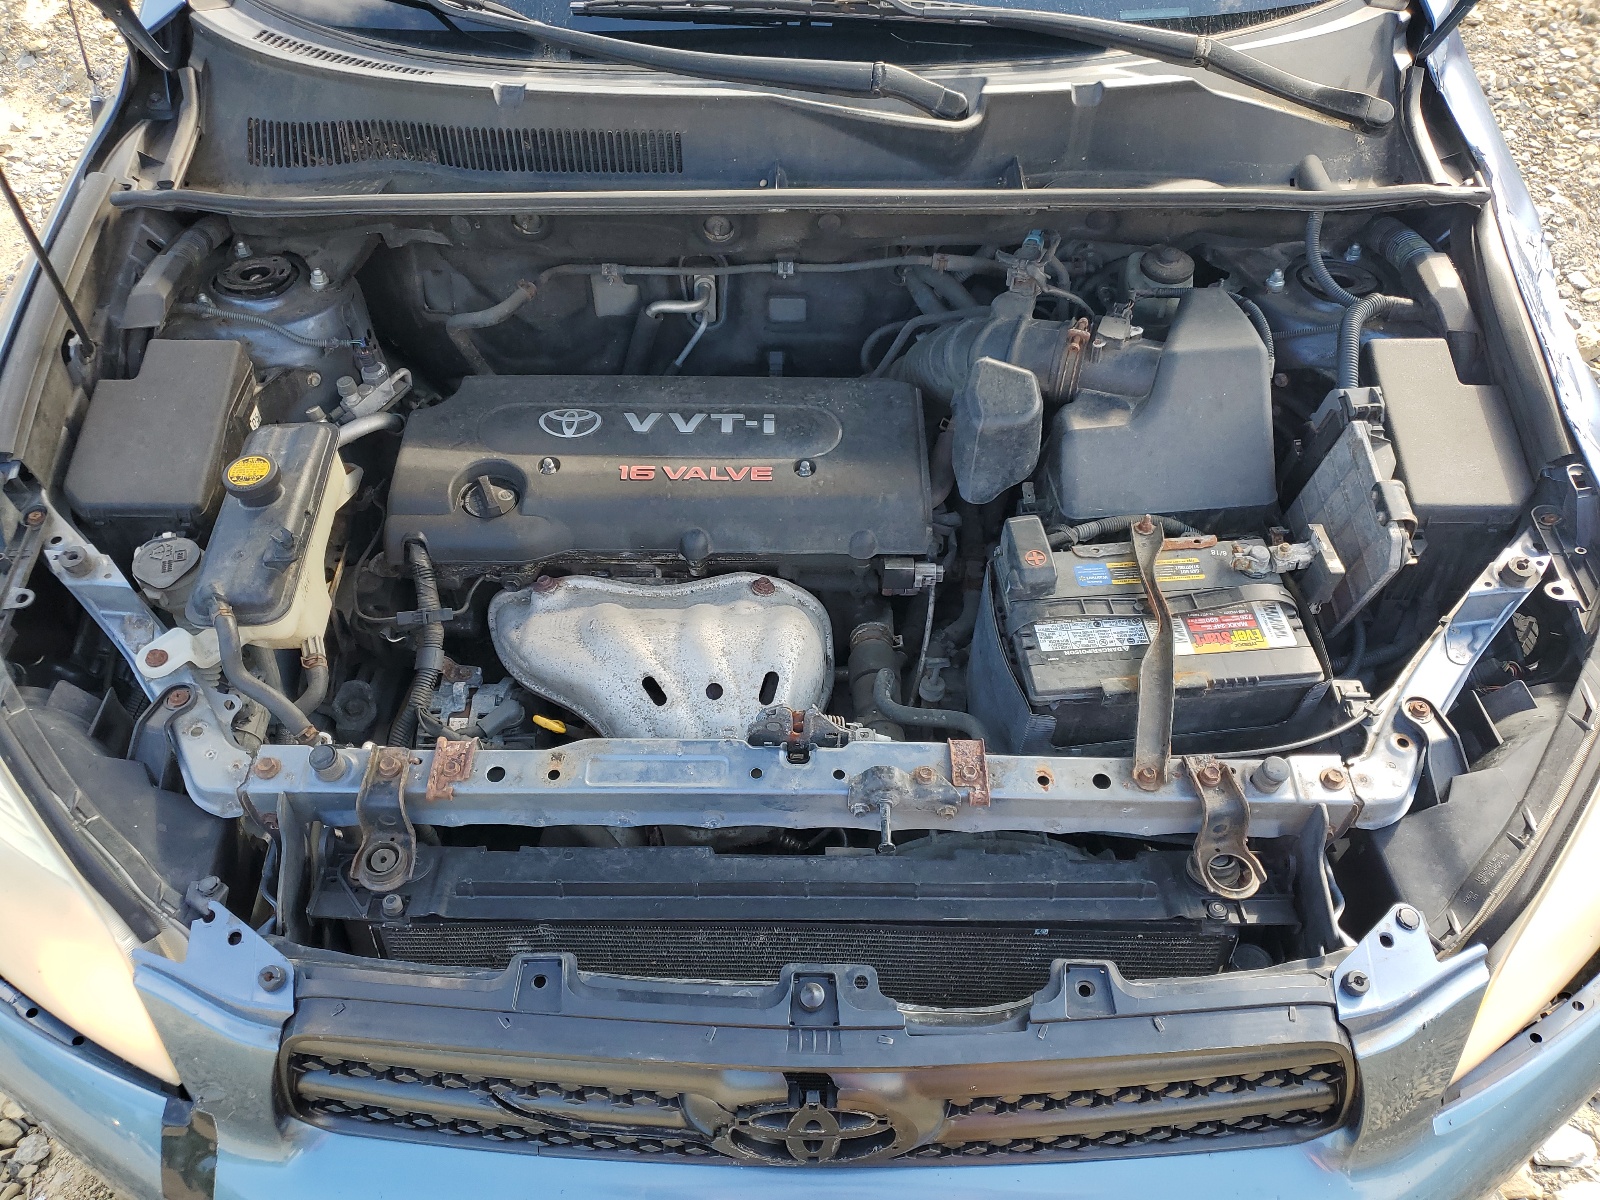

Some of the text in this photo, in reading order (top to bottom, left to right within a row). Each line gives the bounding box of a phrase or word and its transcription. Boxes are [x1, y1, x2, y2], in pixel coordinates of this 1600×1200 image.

[623, 411, 776, 434] VVT-i
[619, 465, 773, 482] 16 VALVE
